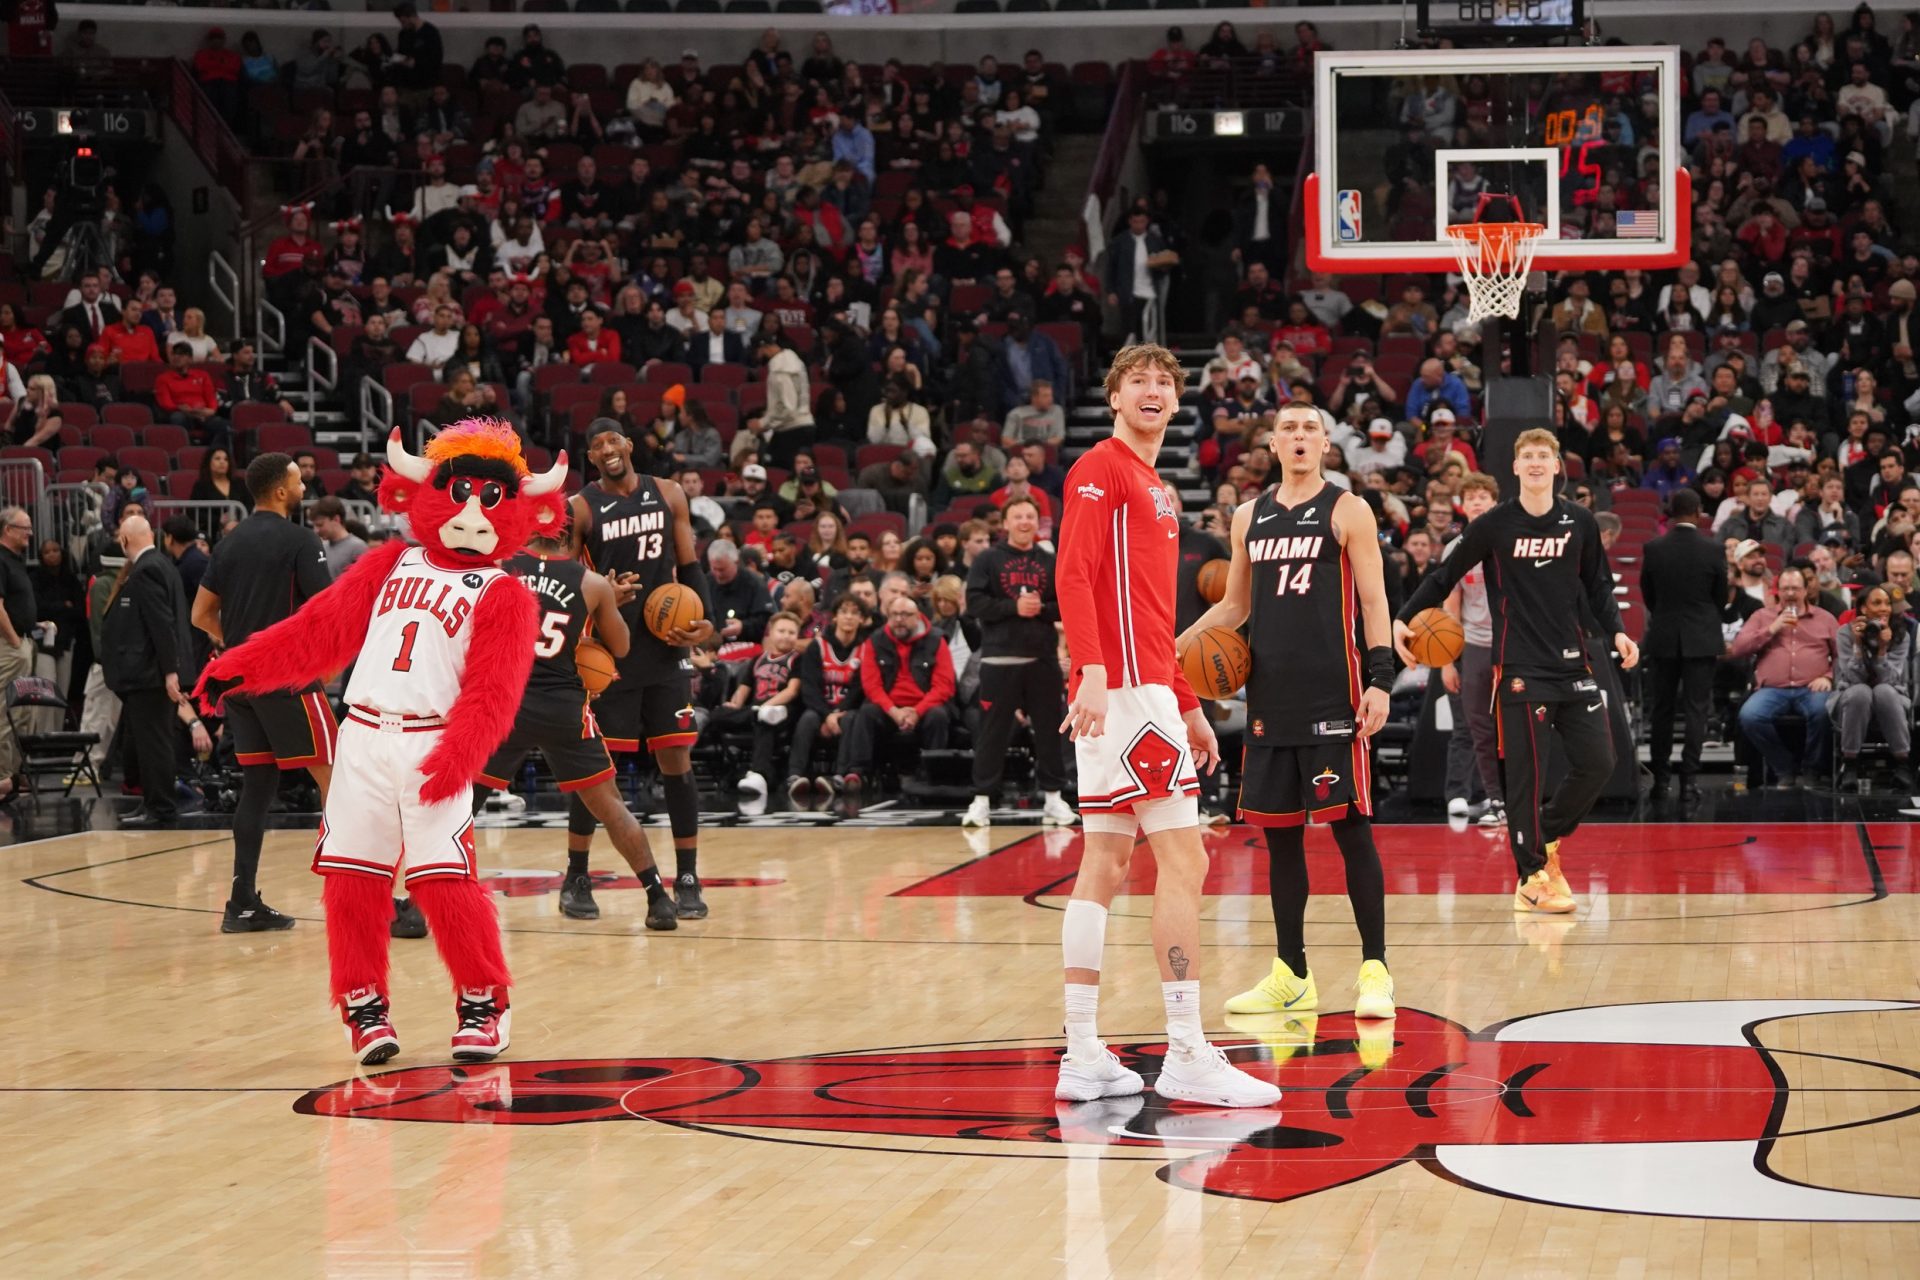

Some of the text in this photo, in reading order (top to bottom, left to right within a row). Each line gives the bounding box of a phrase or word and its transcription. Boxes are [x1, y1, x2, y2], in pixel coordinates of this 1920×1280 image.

[103, 112, 129, 132] 116
[1170, 114, 1197, 134] 116
[1264, 112, 1285, 131] 117
[602, 511, 664, 542] MIAMI
[637, 532, 663, 561] 13
[1248, 536, 1324, 563] MIAMI
[1513, 531, 1571, 558] HEAT
[1276, 563, 1313, 596] 14
[377, 577, 472, 639] BULLS
[391, 620, 420, 673] 1
[1212, 653, 1233, 697] Wilson
